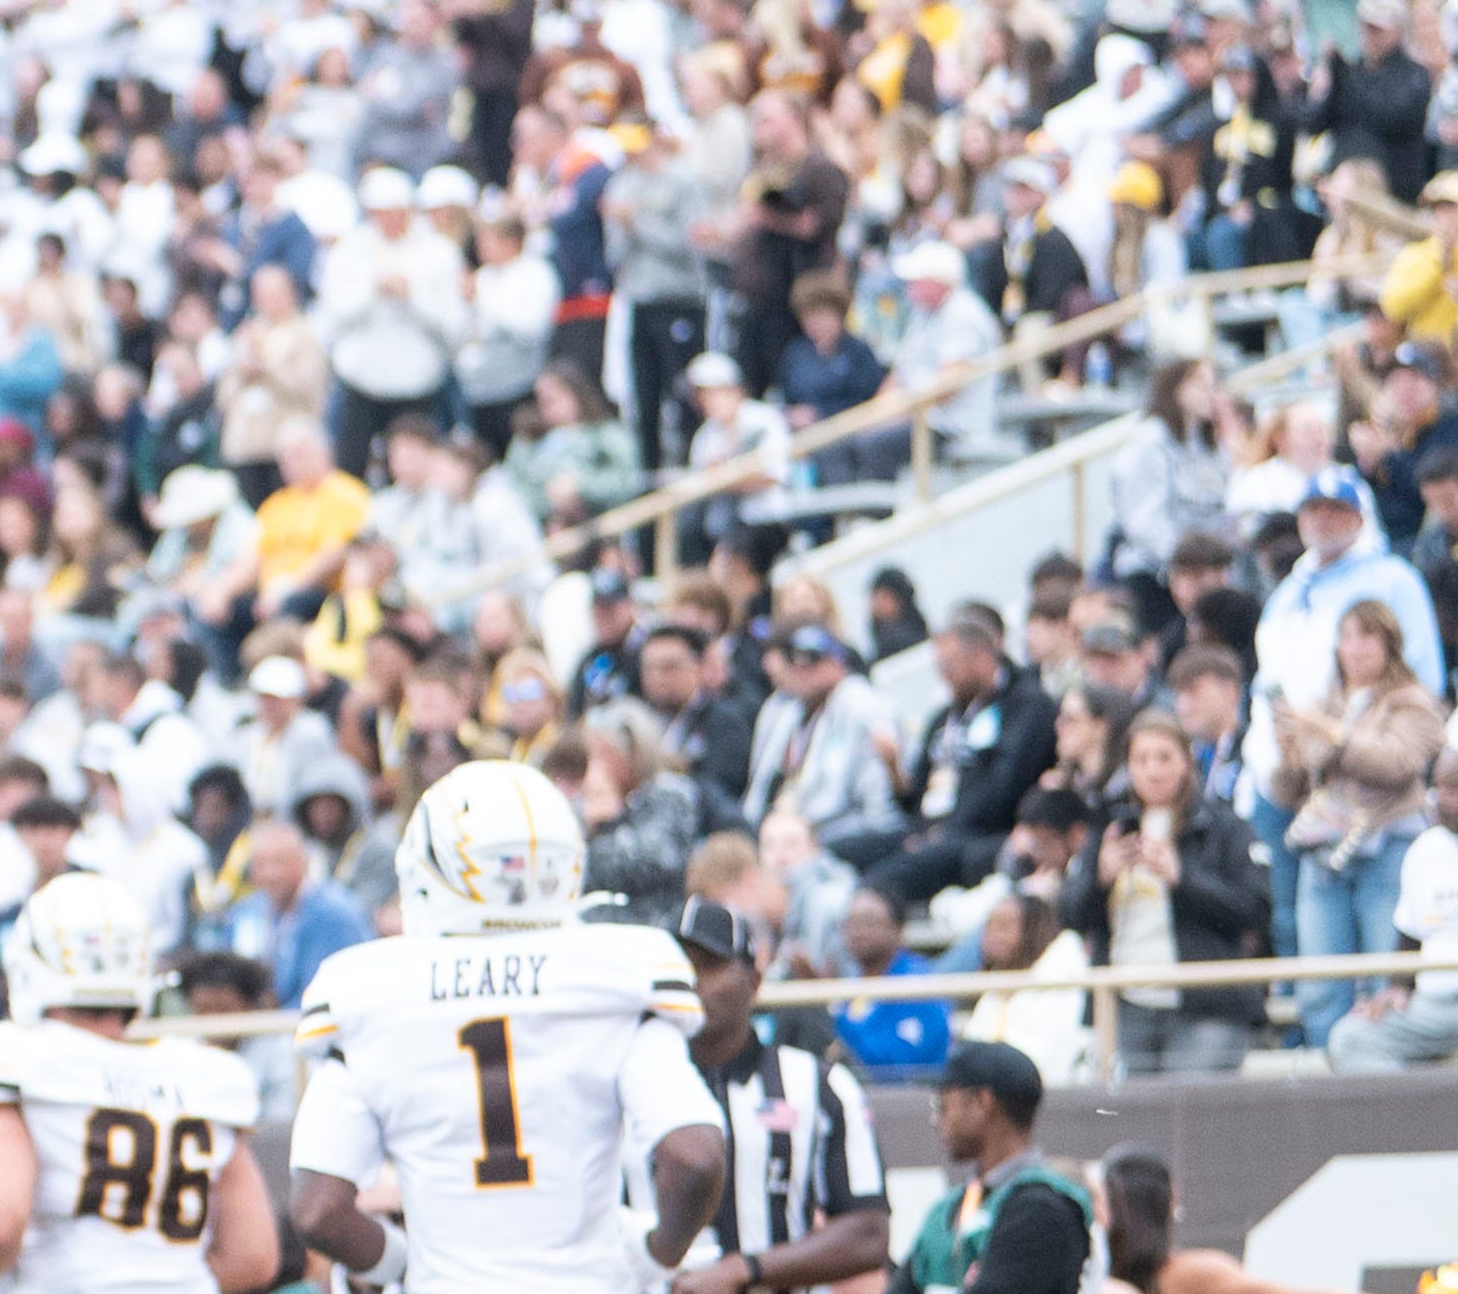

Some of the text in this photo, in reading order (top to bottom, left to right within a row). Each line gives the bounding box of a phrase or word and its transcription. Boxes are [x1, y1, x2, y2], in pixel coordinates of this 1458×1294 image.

[430, 955, 548, 1001] LEARY
[456, 1014, 536, 1190] 1
[75, 1105, 214, 1245] 86
